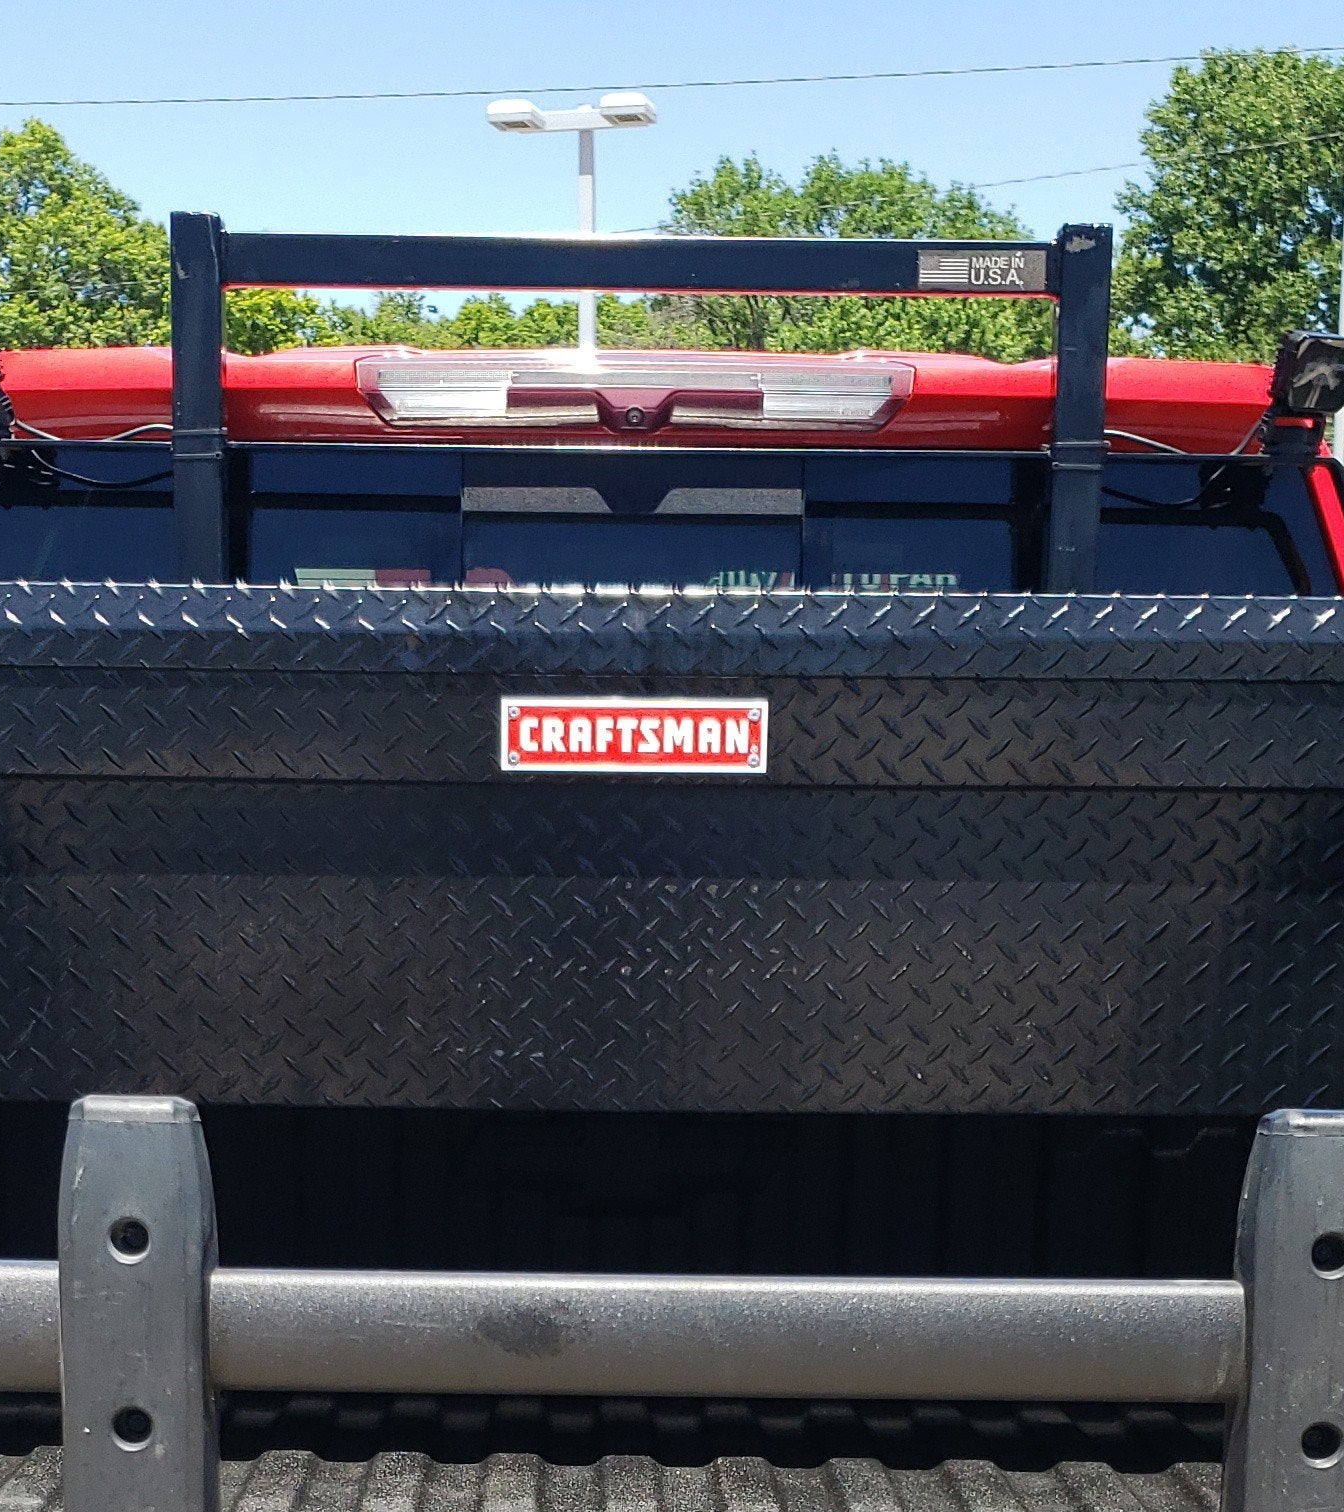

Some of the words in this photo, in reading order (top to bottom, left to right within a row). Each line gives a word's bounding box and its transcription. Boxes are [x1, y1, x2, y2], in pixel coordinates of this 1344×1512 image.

[971, 256, 1009, 269] MADE
[1011, 257, 1025, 269] IN
[519, 716, 749, 753] CRAFTSMAN
